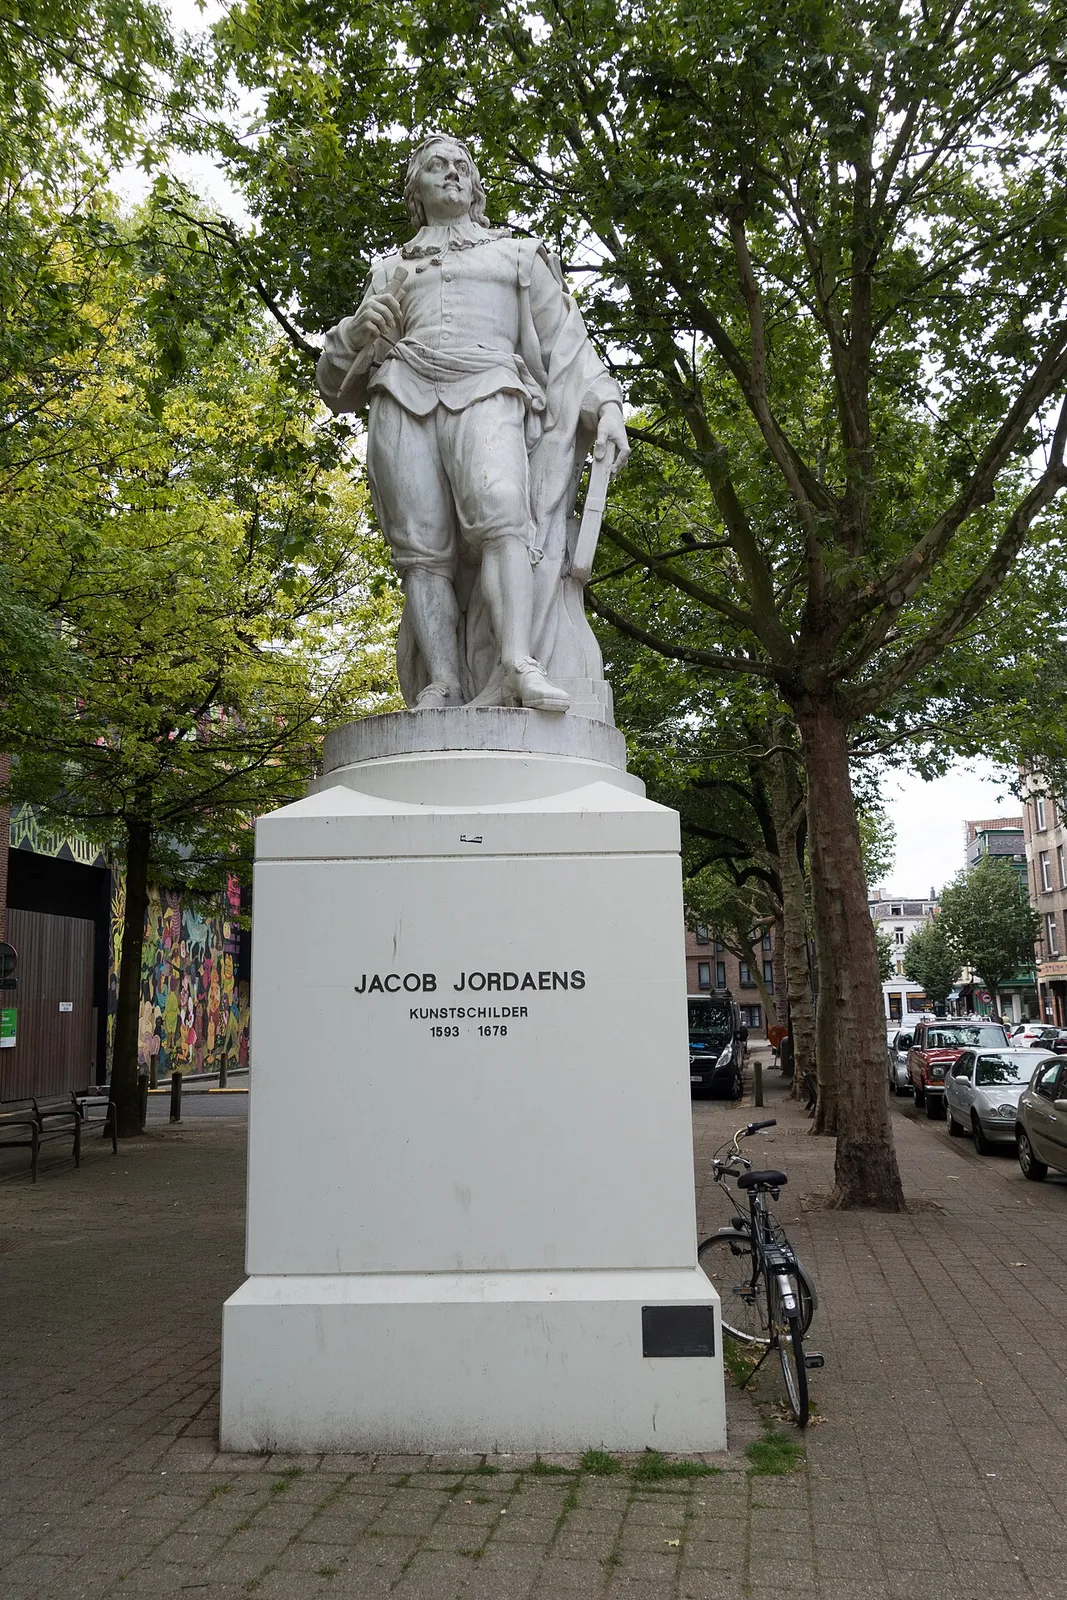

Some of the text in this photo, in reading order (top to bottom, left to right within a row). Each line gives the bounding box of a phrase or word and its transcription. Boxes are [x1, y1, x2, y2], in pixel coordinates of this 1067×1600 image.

[354, 970, 586, 994] JACOB JORDAENS
[409, 1007, 528, 1020] KUNSTSCHILDER
[429, 1025, 508, 1038] 1593 1678
